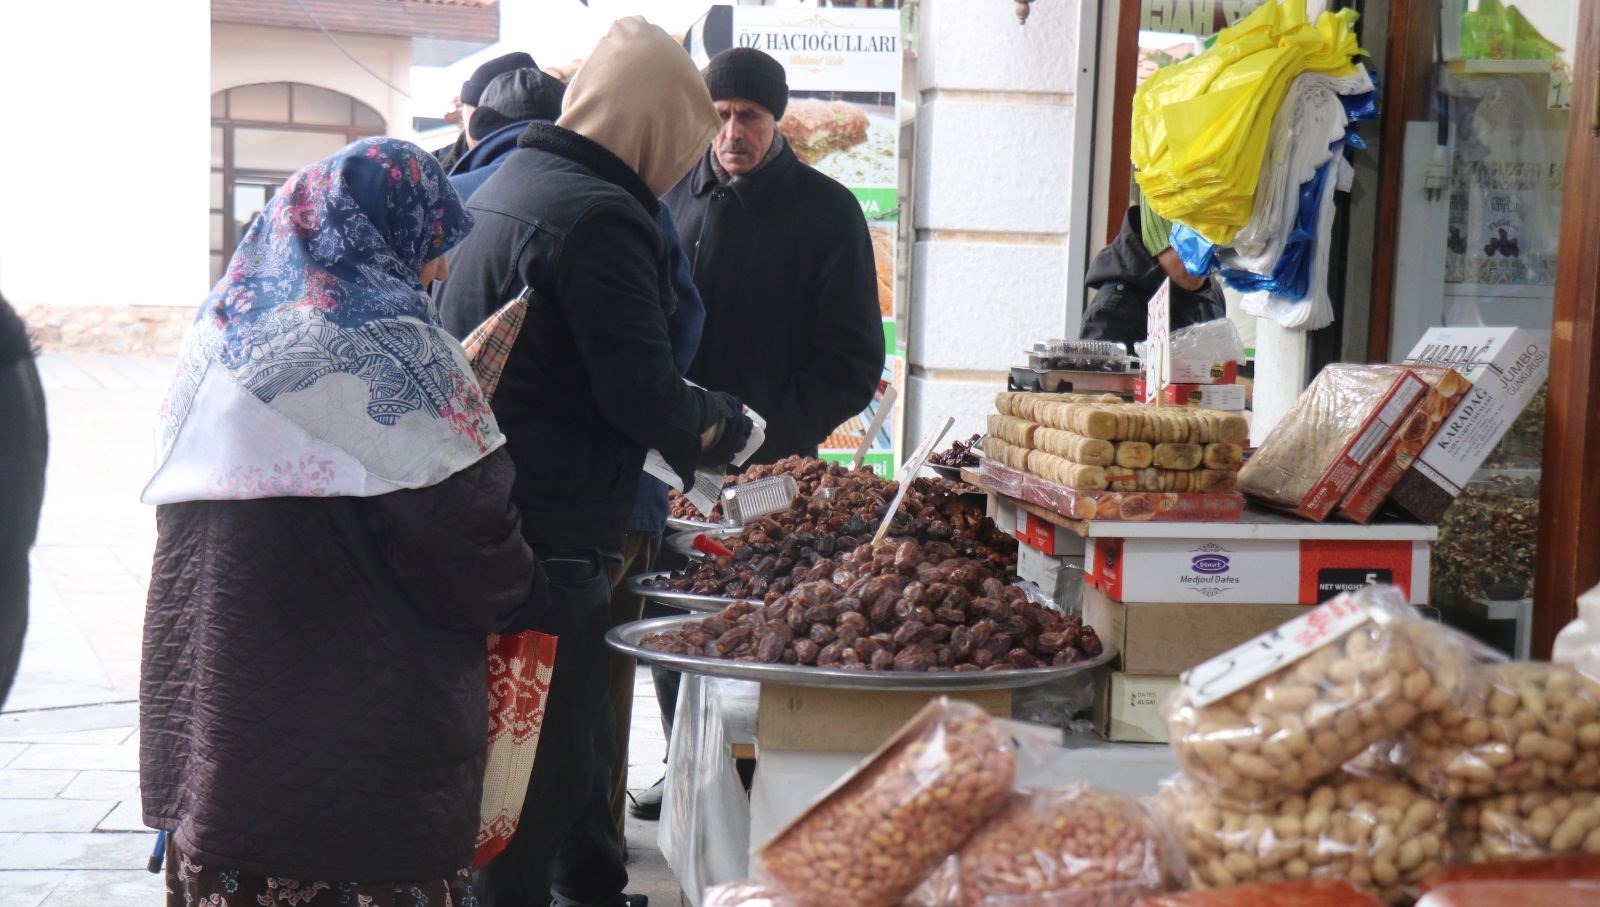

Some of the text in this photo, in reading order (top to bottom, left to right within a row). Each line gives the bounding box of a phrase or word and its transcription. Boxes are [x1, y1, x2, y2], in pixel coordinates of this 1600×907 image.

[739, 28, 896, 53] ÖZ HACIOĞULLARI
[1500, 344, 1538, 389] JUMBO
[1437, 387, 1487, 449] KARADAĞ
[1180, 575, 1240, 585] Medjoul Dates
[1365, 573, 1377, 586] 5
